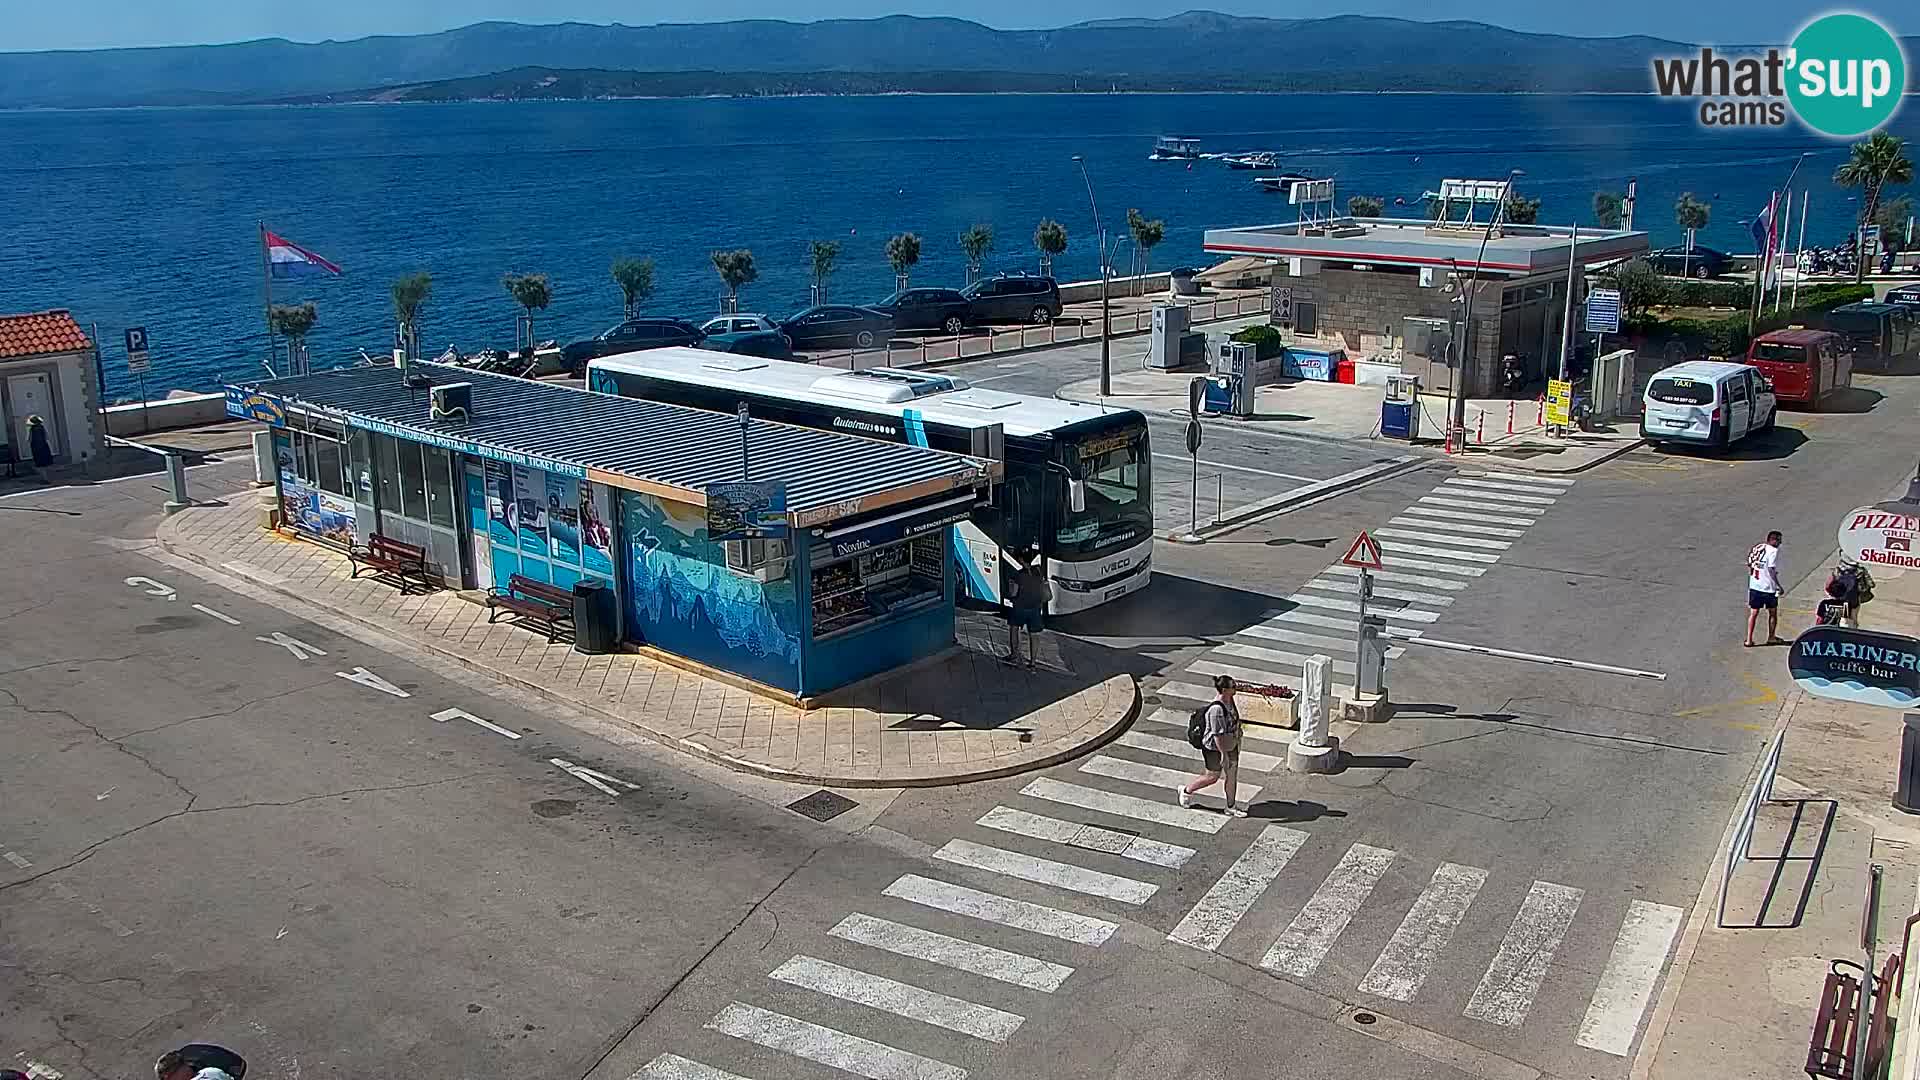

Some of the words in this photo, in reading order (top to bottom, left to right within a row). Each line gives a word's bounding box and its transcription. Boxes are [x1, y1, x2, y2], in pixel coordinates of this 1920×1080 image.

[130, 331, 142, 349] P
[1673, 379, 1692, 388] TAXI
[395, 426, 436, 445] AUTOBUSNA
[436, 437, 468, 451] POSTAJA
[478, 446, 493, 457] BUS
[494, 450, 527, 465] STATION
[528, 456, 555, 472] TICKET
[555, 463, 583, 477] OFFICE
[1848, 514, 1920, 533] PIZZE
[1882, 529, 1918, 540] GRILL
[1101, 557, 1130, 576] IVECO
[1829, 660, 1866, 675] caffe
[1871, 664, 1898, 679] bar
